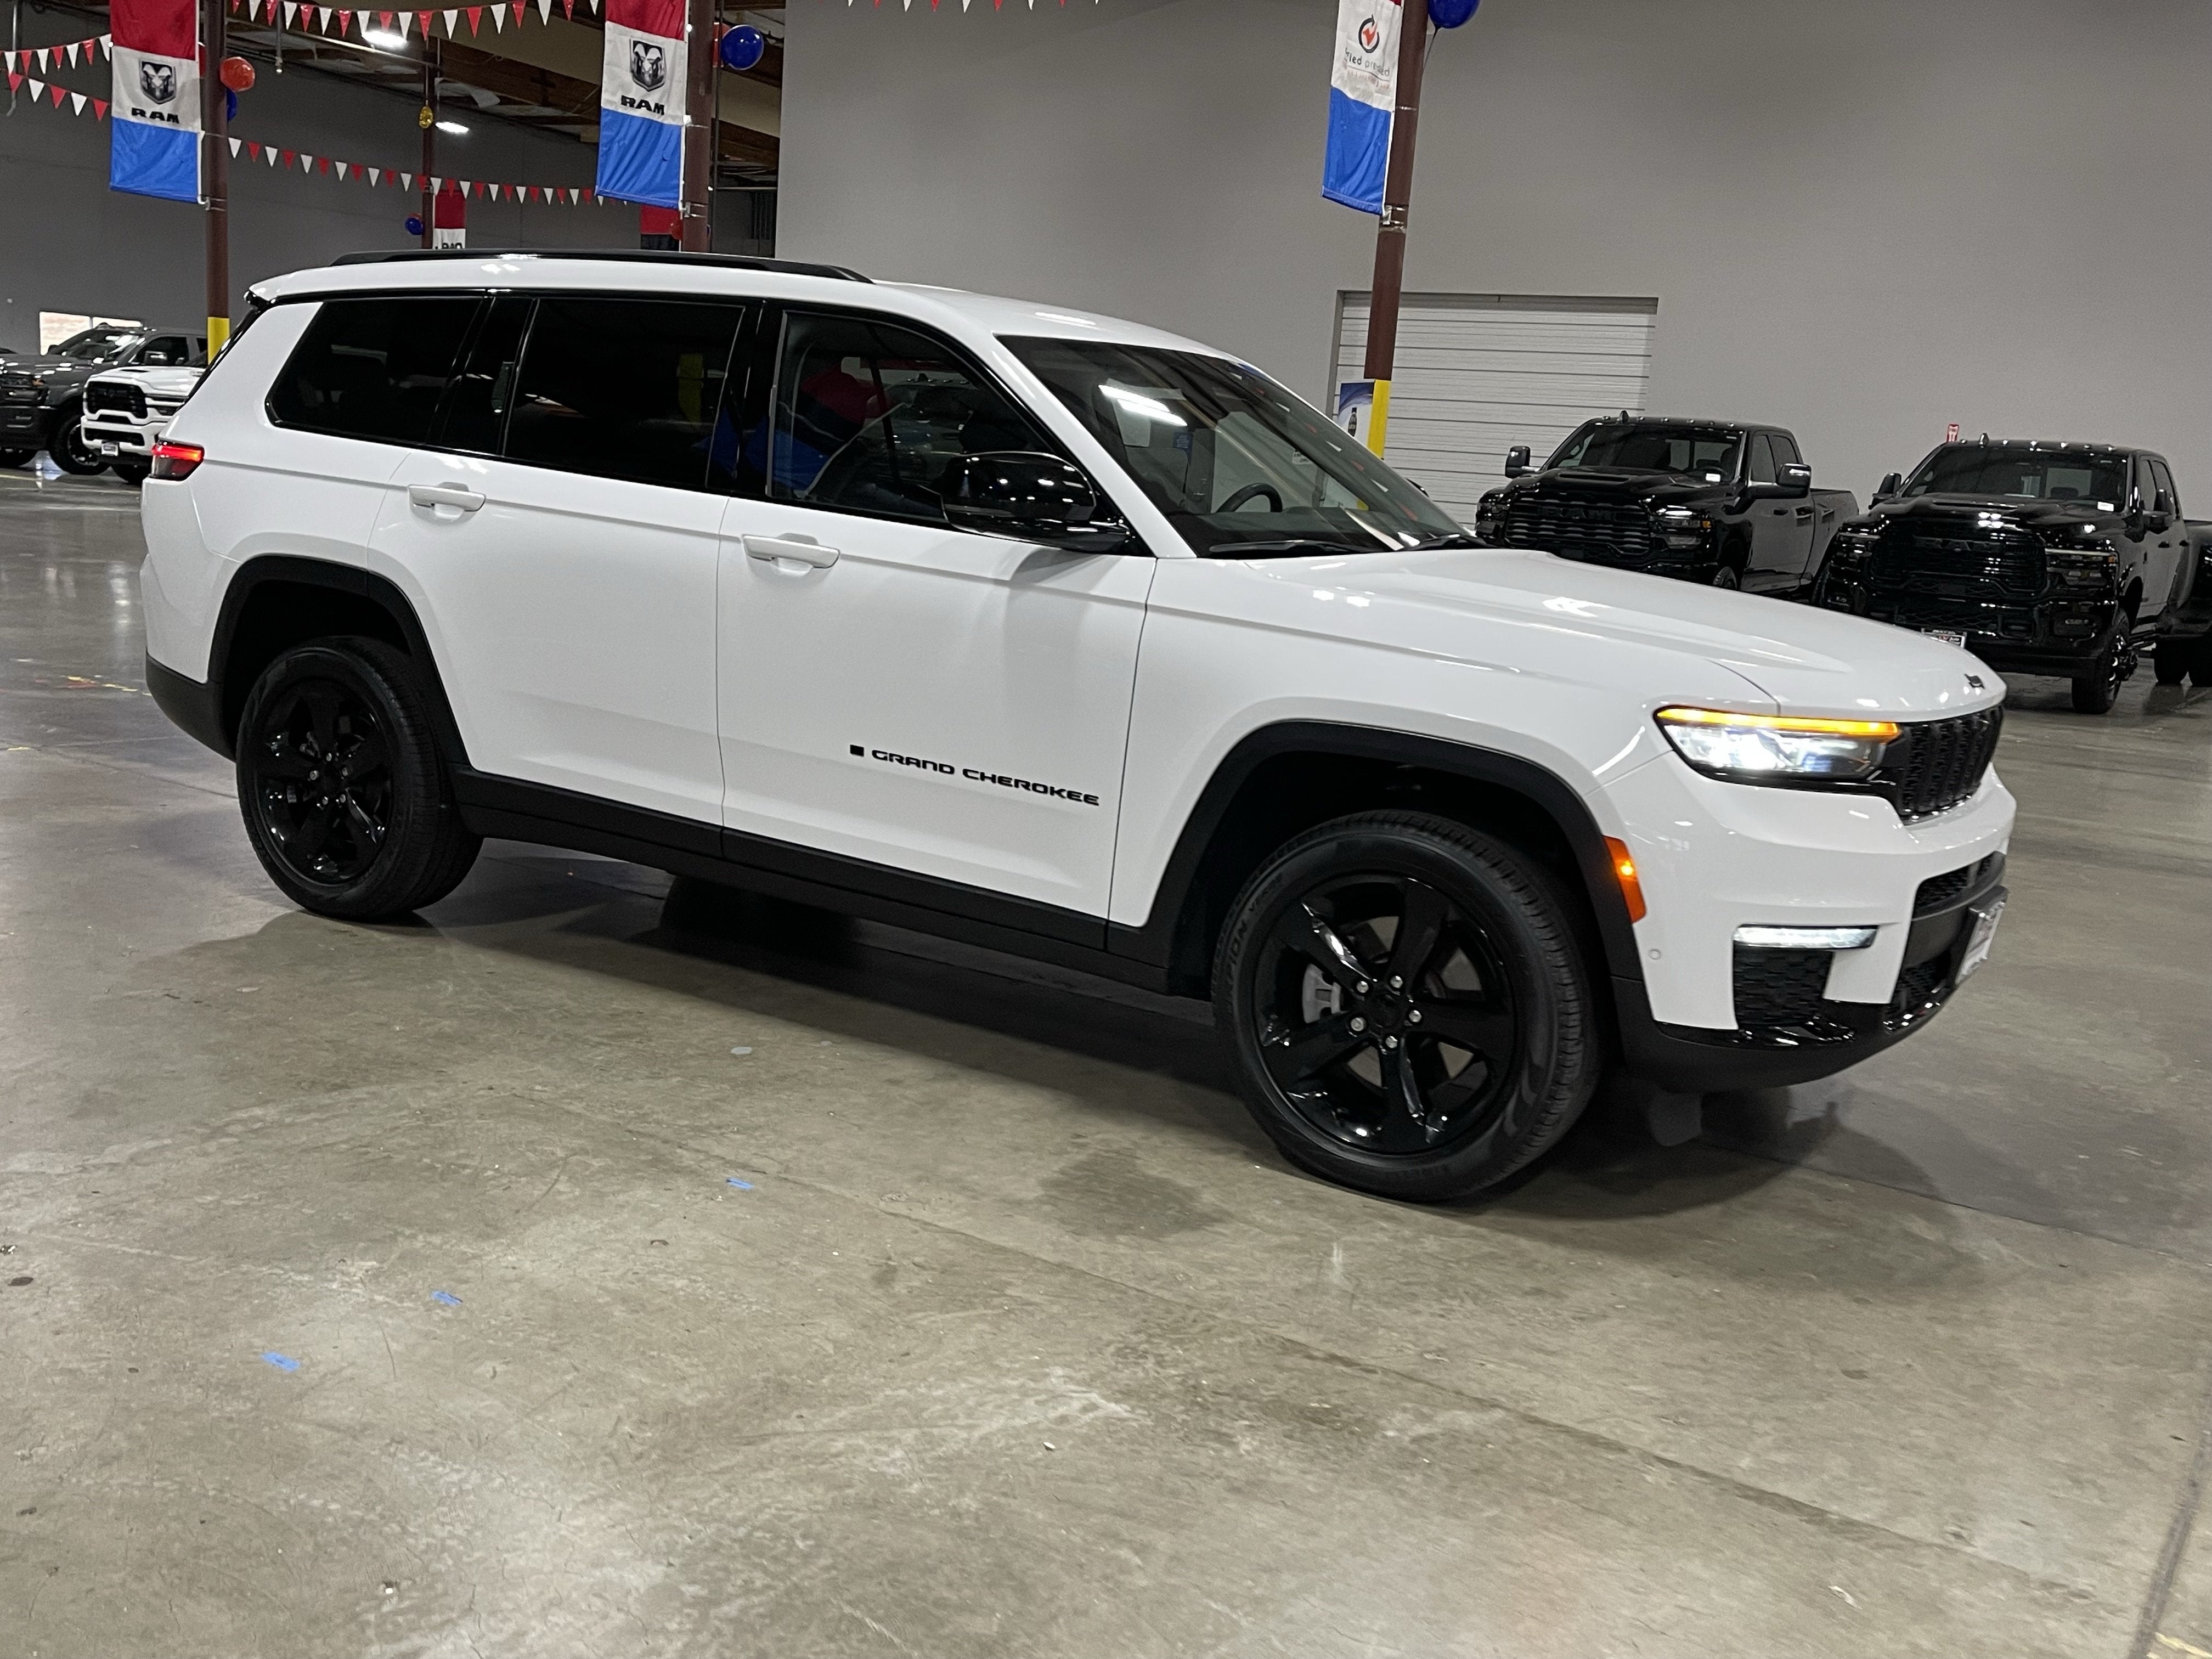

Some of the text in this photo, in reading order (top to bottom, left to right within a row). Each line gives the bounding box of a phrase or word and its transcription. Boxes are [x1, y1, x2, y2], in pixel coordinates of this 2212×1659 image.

[621, 95, 664, 115] RAM
[132, 108, 179, 124] RAM
[872, 749, 1099, 805] GRAND CHEROKEE
